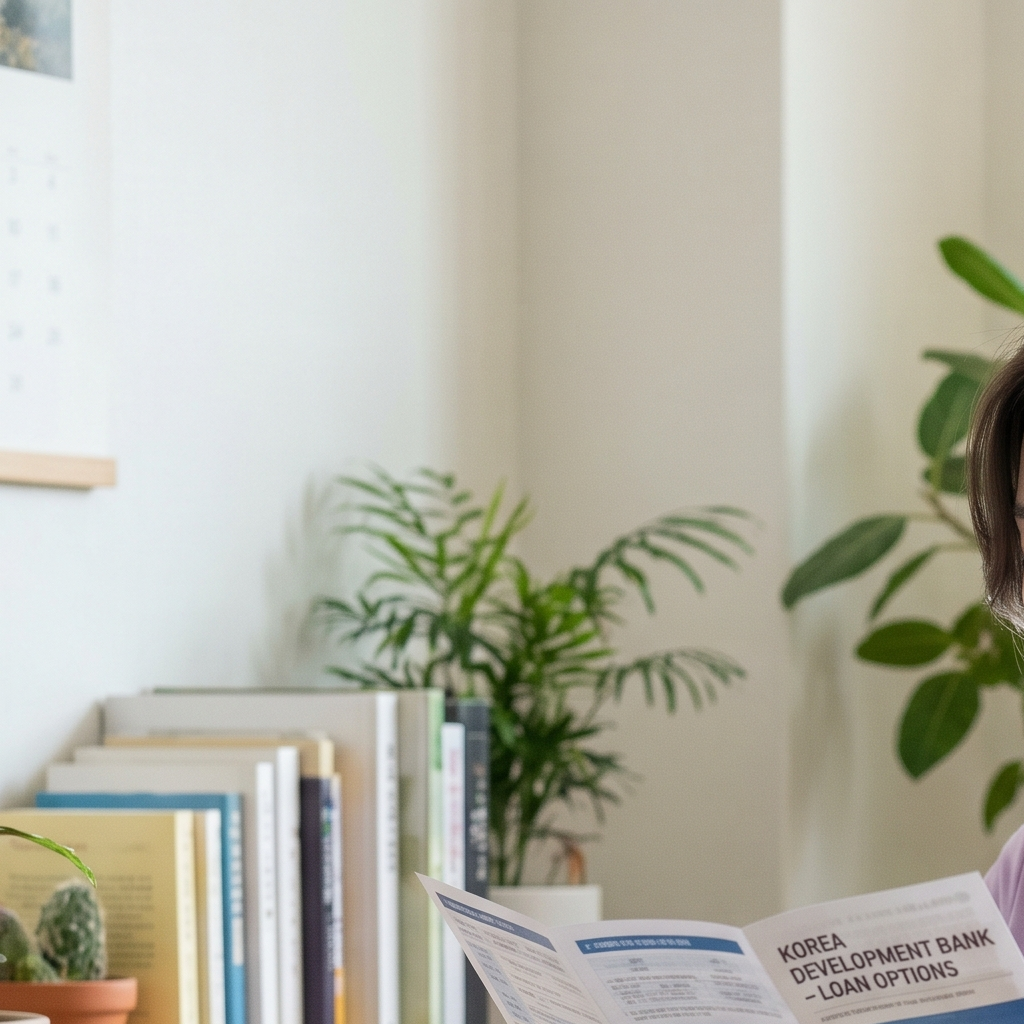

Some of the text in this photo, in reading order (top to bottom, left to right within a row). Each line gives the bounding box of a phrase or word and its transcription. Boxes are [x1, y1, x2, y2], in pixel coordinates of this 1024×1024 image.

[777, 932, 847, 963] KOREA
[789, 928, 995, 985] DEVELOPMENT BANK
[817, 975, 872, 1001] LOAN
[873, 960, 960, 989] OPTIONS
